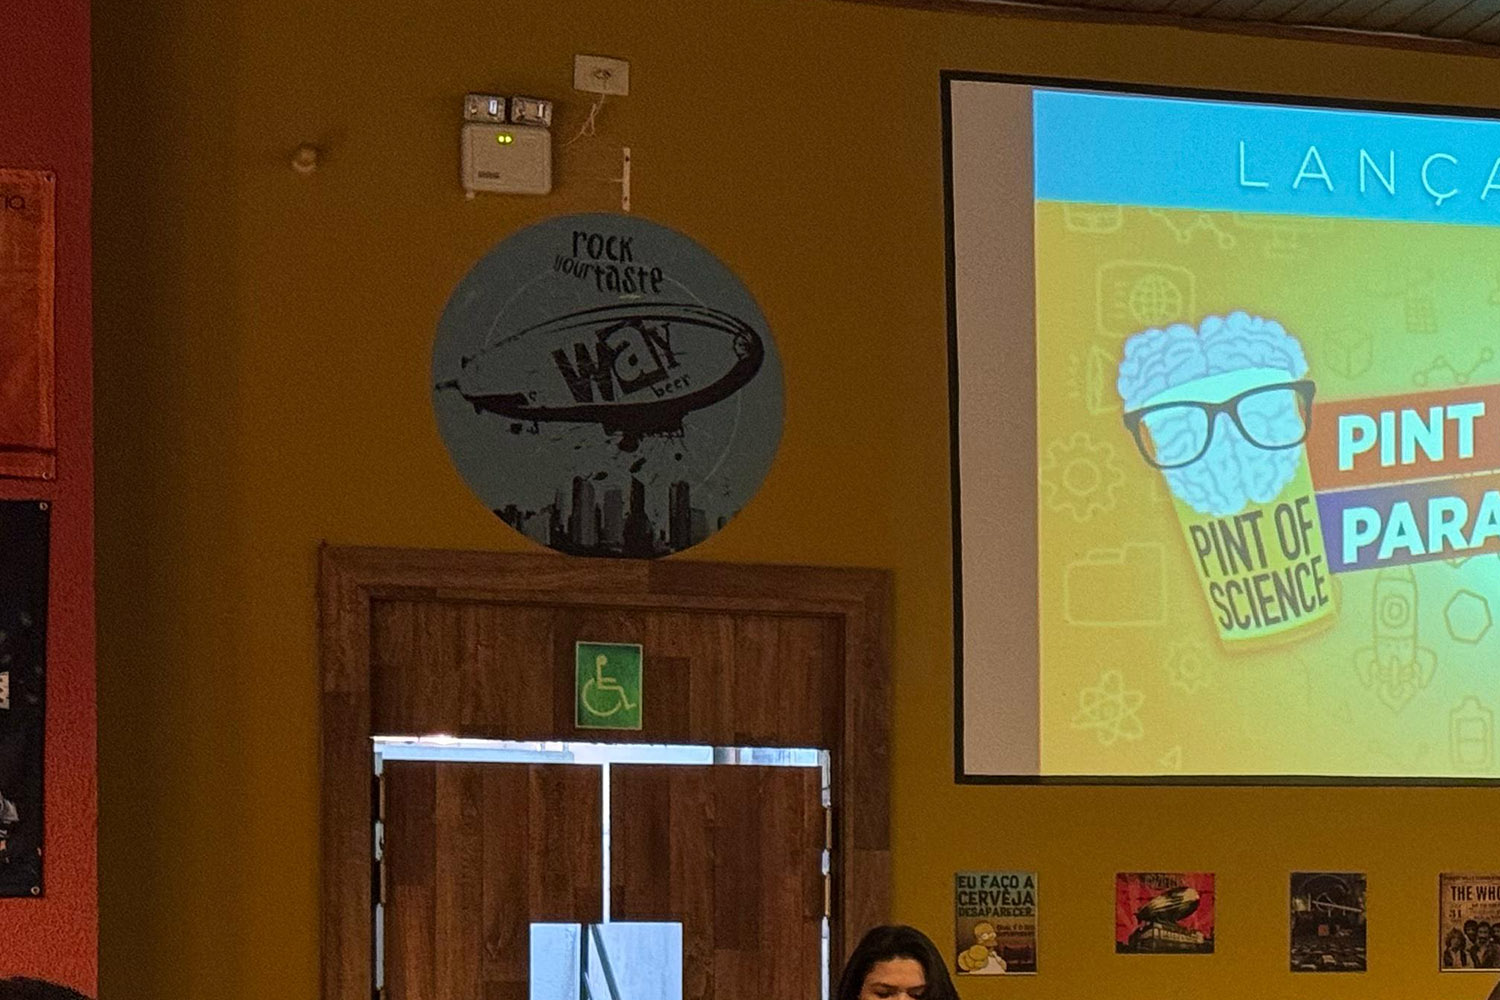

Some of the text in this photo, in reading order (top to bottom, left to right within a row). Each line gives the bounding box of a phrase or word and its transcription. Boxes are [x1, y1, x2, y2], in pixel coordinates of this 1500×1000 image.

[594, 264, 663, 294] taste
[1337, 401, 1486, 472] PINT
[1189, 496, 1313, 578] PINT OF
[1209, 555, 1330, 631] SCIENCE
[958, 875, 1035, 891] EU FAÇO A
[958, 890, 1035, 906] CERVEJA
[1450, 885, 1473, 901] THE
